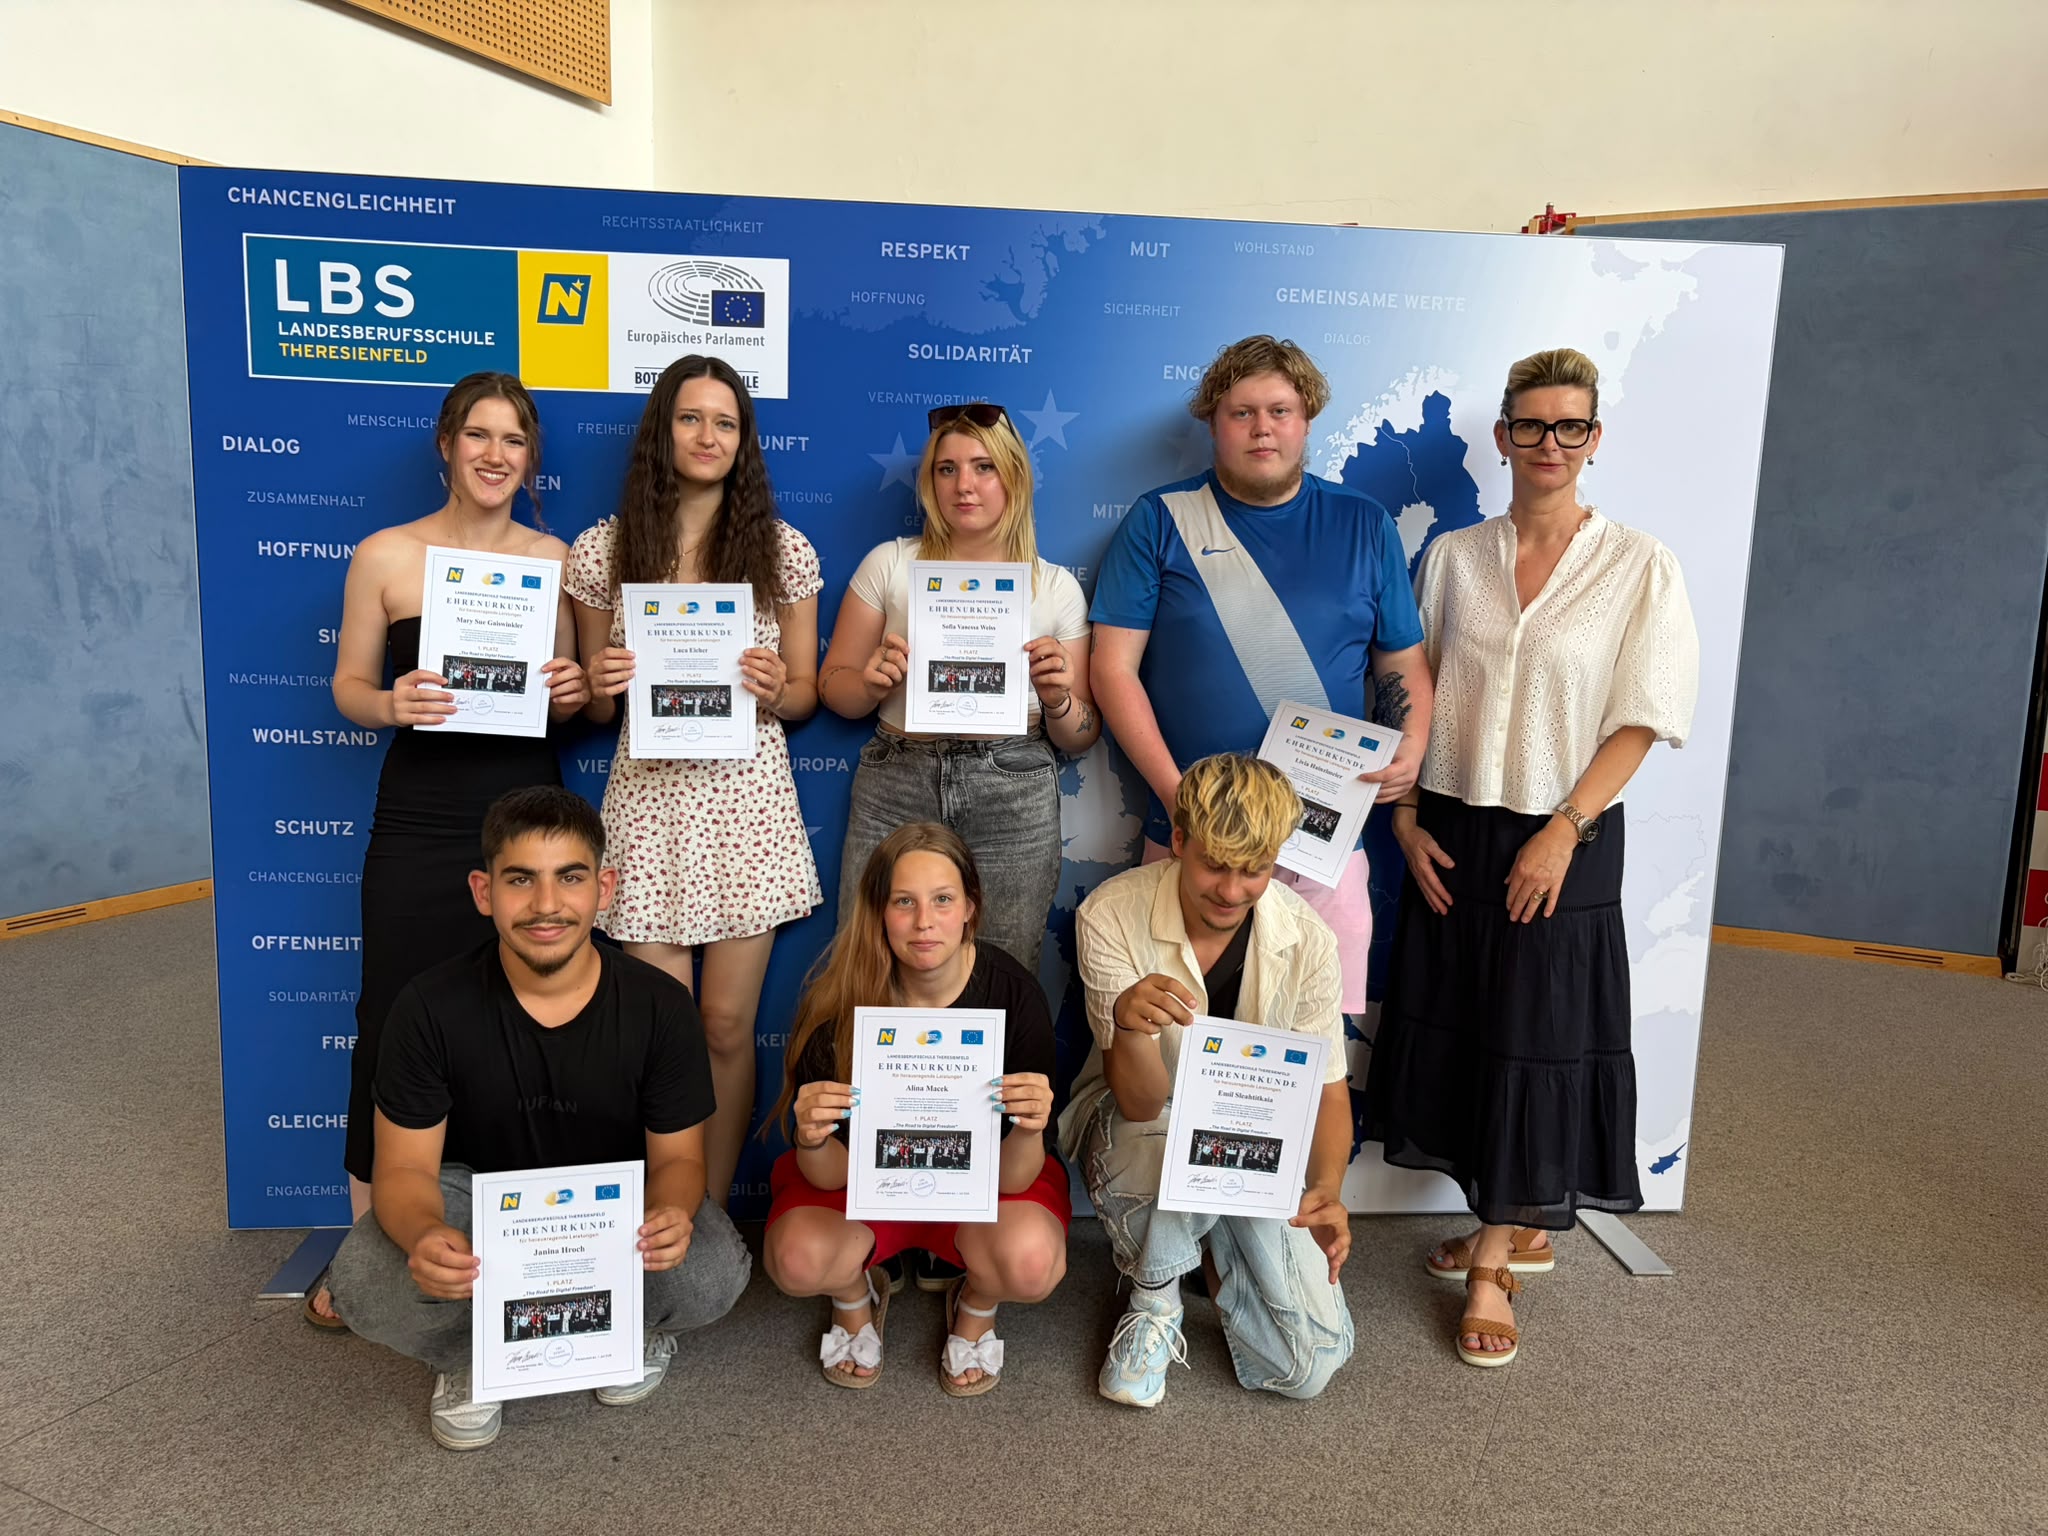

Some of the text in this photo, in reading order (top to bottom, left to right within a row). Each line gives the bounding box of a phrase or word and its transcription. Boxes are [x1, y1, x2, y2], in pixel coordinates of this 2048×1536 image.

[228, 187, 456, 215] CHANCENGLEICHHEIT
[602, 215, 764, 233] RECHTSSTAATLICHKEIT
[881, 241, 970, 261] RESPEKT
[1131, 241, 1170, 258] MUT
[1234, 241, 1314, 256] WOHLSTAND
[275, 258, 415, 318] LBS
[851, 292, 925, 305] HOFFNUNG
[1276, 287, 1466, 312] GEMEINSAME WERTE
[1104, 303, 1181, 317] SICHERHEIT
[278, 321, 495, 346] LANDESBERUFSSCHULE
[627, 330, 765, 346] Europäisches Parlament
[1324, 332, 1370, 346] DIALOG
[279, 343, 427, 364] THERESIENFELD
[908, 343, 1033, 364] SOLIDARITÄT
[348, 414, 438, 429] MENSCHLICH
[578, 423, 639, 435] FREIHEIT
[222, 435, 300, 454] DIALOG
[759, 435, 809, 451] UNFT
[247, 491, 365, 507] ZUSAMMENHALT
[258, 540, 356, 559] HOFFNUN
[446, 597, 535, 612] EHRENURKUNDE
[929, 606, 1010, 614] EHRENURKUNDE
[456, 616, 473, 624] Mary
[252, 728, 378, 746] WOHLSTAND
[1285, 738, 1365, 770] EHRENURKUNDE
[275, 820, 354, 836] SCHUTZ
[249, 871, 363, 884] CHANCENGLEICH
[252, 935, 362, 951] OFFENHEIT
[268, 990, 356, 1002] SOLIDARITÄT
[878, 1062, 978, 1072] EHRENURKUNDE
[1201, 1068, 1298, 1088] EHRENURKUNDE
[906, 1084, 924, 1092] Alina
[1218, 1090, 1234, 1098] Emil
[268, 1114, 349, 1129] GLEICHE
[266, 1185, 349, 1196] ENGAGEMEN
[503, 1220, 615, 1237] EHRENURKUNDE
[533, 1245, 585, 1256] Janina Hroch
